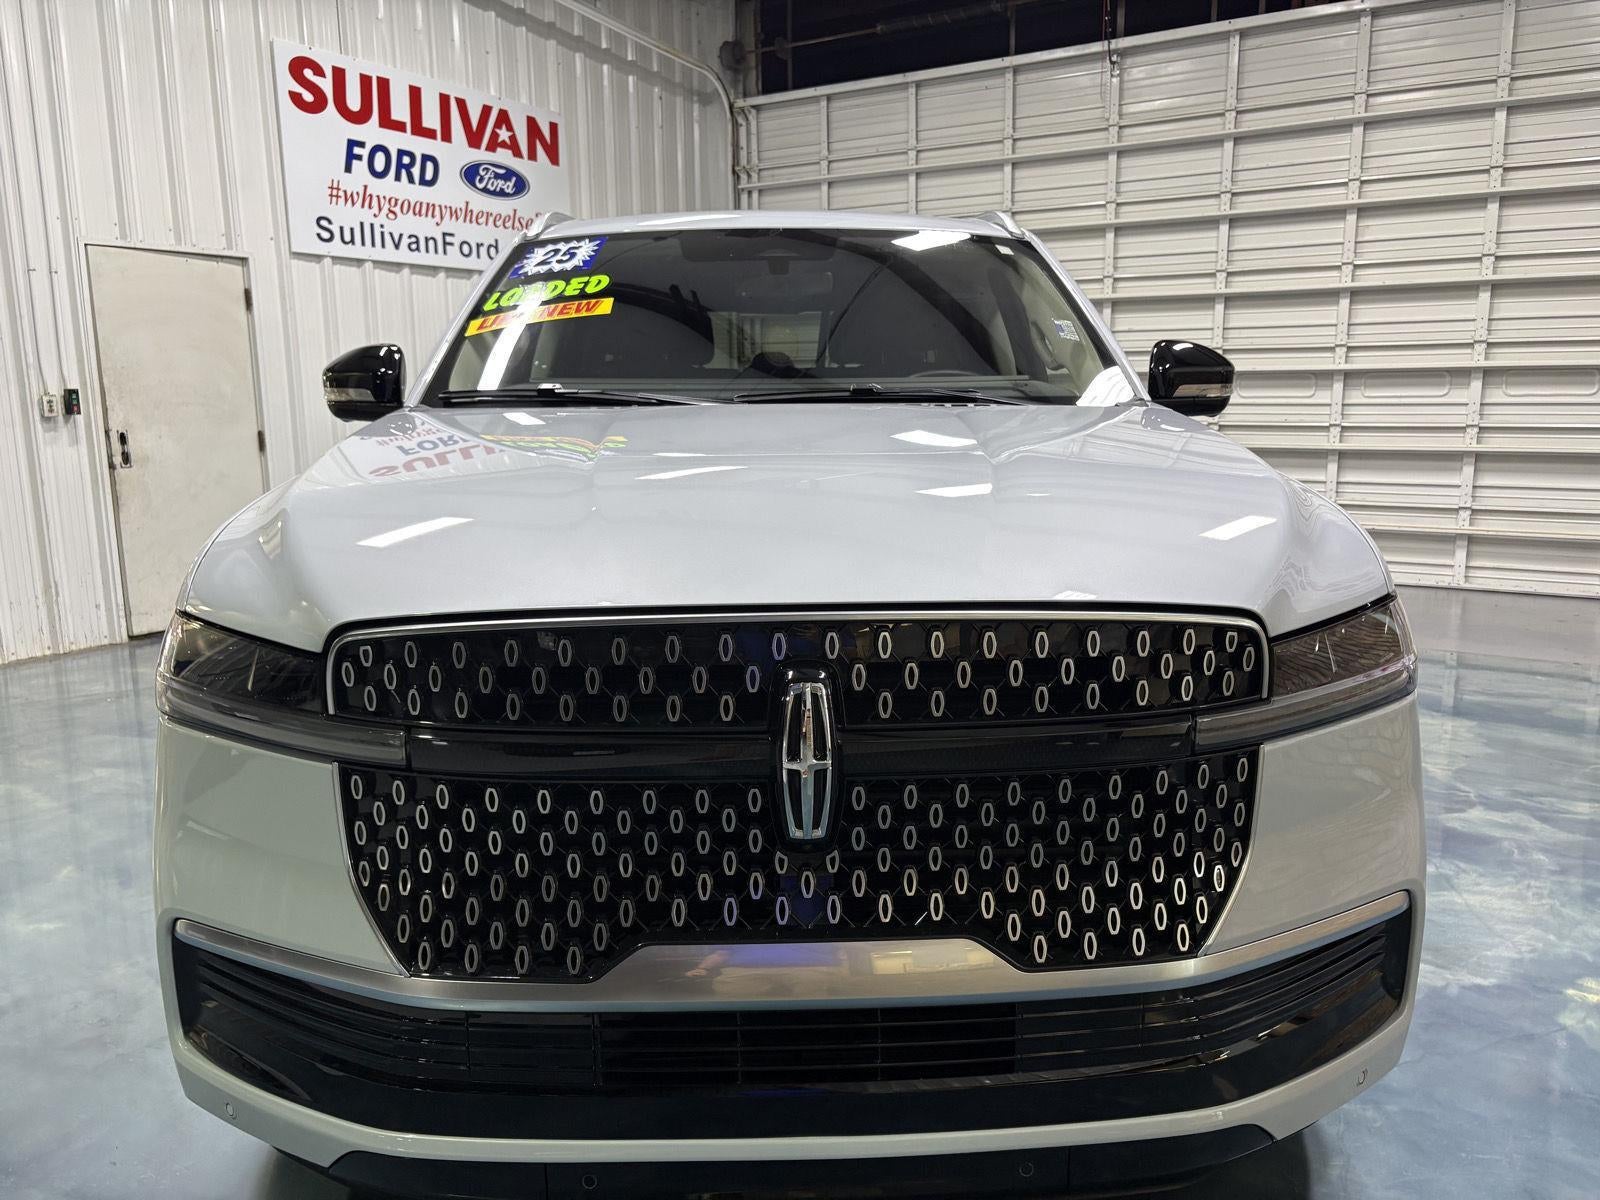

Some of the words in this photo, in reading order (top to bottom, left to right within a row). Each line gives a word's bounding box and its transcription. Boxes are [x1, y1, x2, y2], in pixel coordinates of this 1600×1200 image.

[287, 55, 560, 167] SULLIVAN
[344, 138, 440, 188] FORD
[475, 164, 517, 194] Ford
[533, 245, 583, 267] 25
